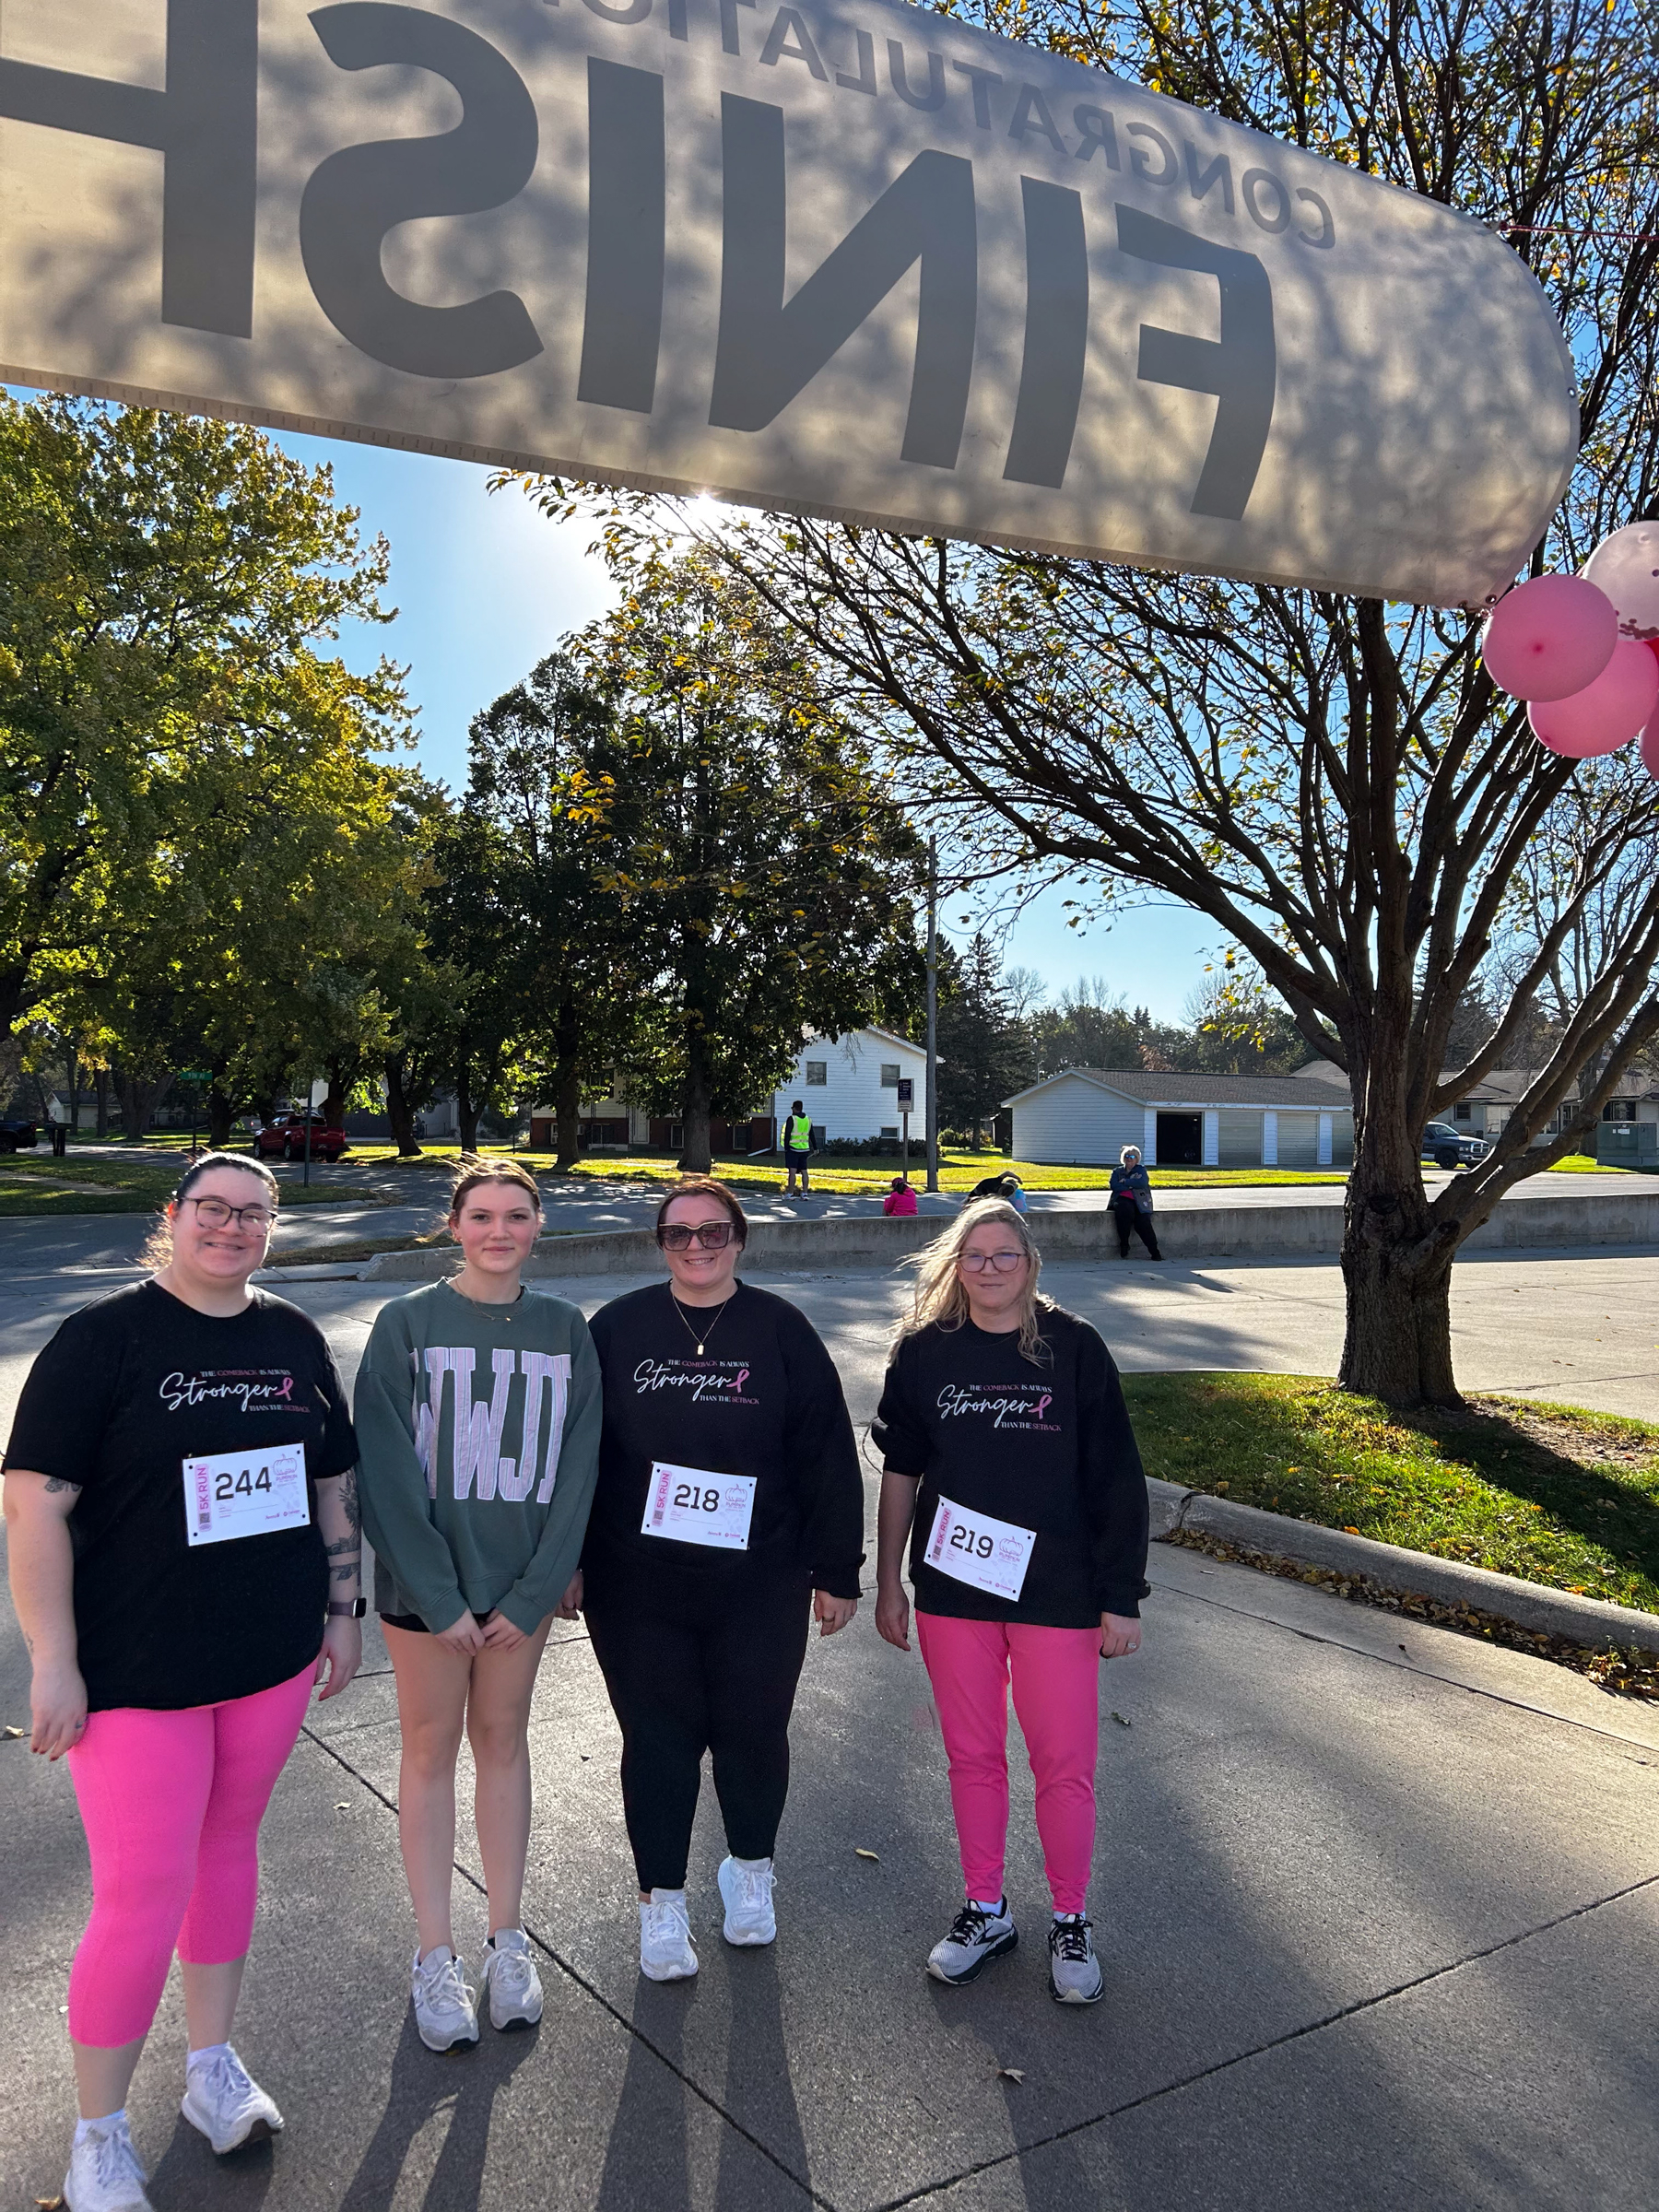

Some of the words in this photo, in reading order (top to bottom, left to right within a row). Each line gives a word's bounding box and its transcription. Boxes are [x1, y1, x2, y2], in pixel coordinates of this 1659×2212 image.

[682, 1359, 718, 1368] COMEBACK
[634, 1359, 732, 1401] Stronger
[1028, 1384, 1052, 1393] ALWAYS
[159, 1371, 277, 1412] Stronger
[732, 1395, 759, 1405] SETBACK
[937, 1383, 1033, 1428] Stronger
[1032, 1423, 1062, 1431] SETBACK
[197, 1467, 208, 1492] RUN
[215, 1466, 272, 1500] 244
[659, 1473, 670, 1494] RUN
[199, 1495, 209, 1510] 5K
[657, 1496, 665, 1509] 5K
[674, 1484, 720, 1512] 218
[940, 1511, 950, 1532] RUN
[936, 1533, 945, 1545] 5K
[950, 1524, 994, 1559] 219
